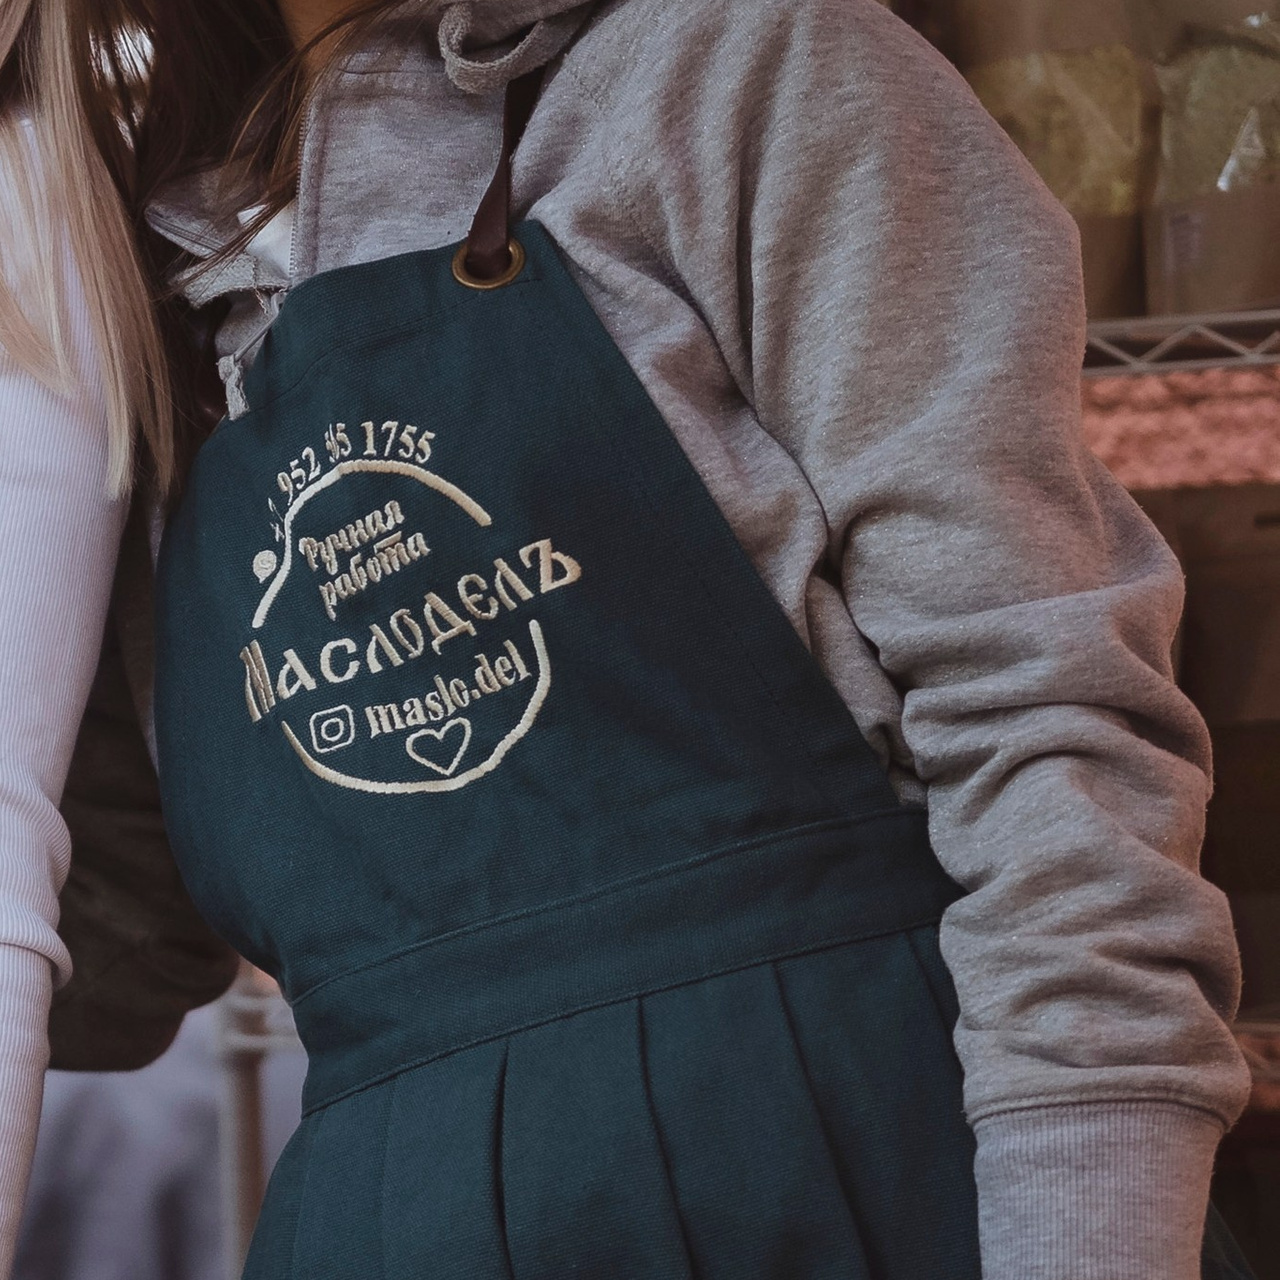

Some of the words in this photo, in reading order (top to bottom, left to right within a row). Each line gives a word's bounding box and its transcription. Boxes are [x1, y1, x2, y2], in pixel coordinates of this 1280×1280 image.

[277, 446, 321, 506] 952
[360, 421, 436, 464] 1755
[299, 500, 405, 575] Ручная
[319, 531, 431, 621] работа
